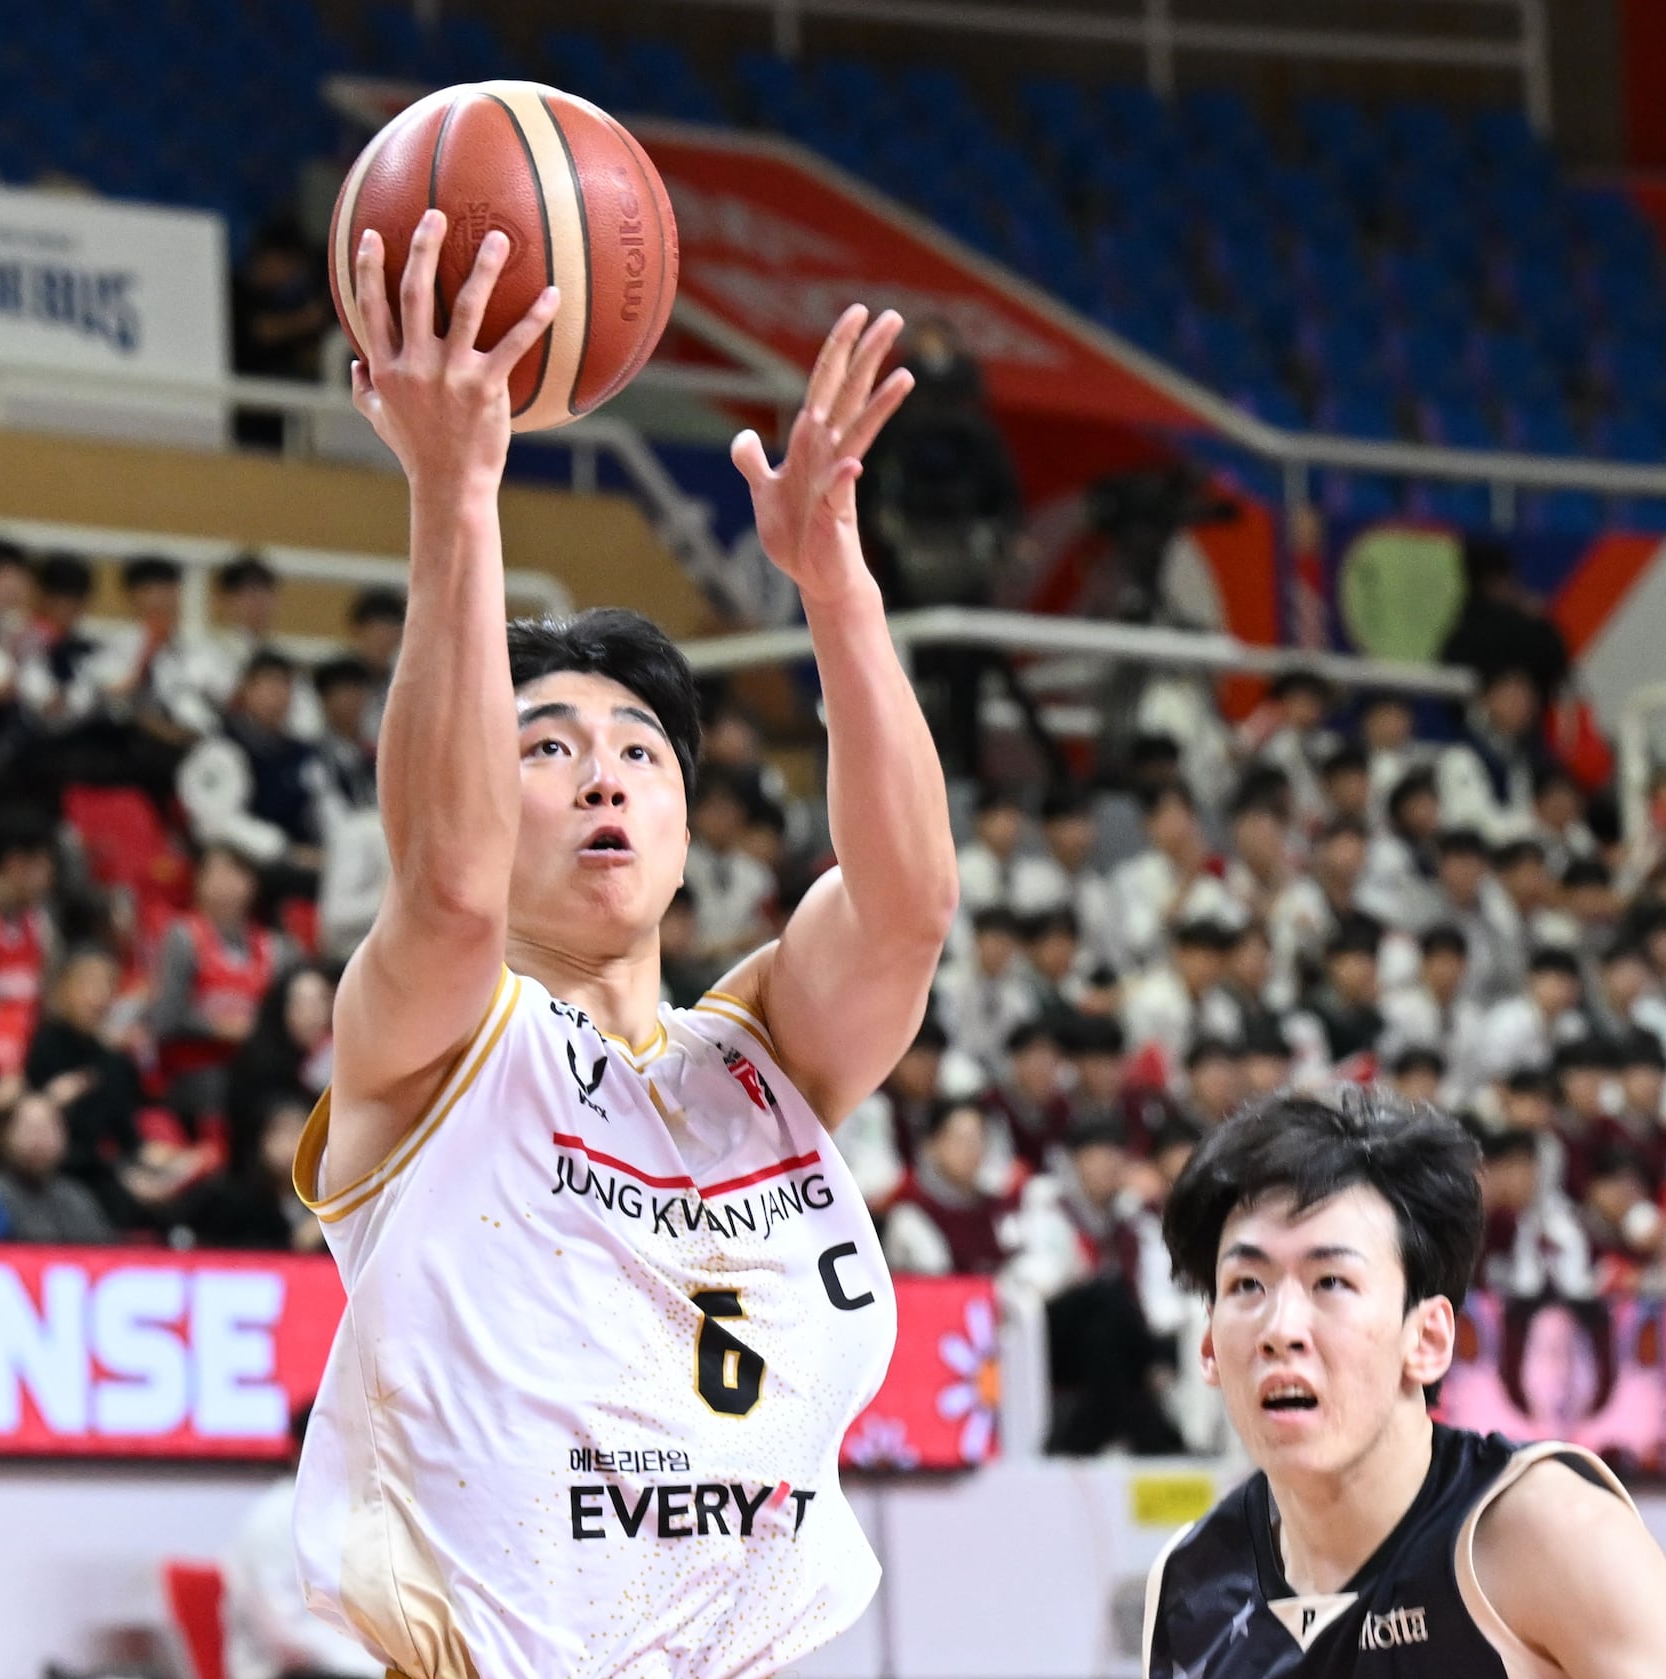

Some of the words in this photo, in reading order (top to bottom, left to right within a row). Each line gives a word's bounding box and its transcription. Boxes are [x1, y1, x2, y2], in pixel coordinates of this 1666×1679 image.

[551, 1155, 643, 1218] JUNG
[760, 1173, 835, 1240] JANG
[817, 1241, 876, 1311] C
[690, 1286, 767, 1421] 6
[569, 1447, 691, 1473] 에브리타임
